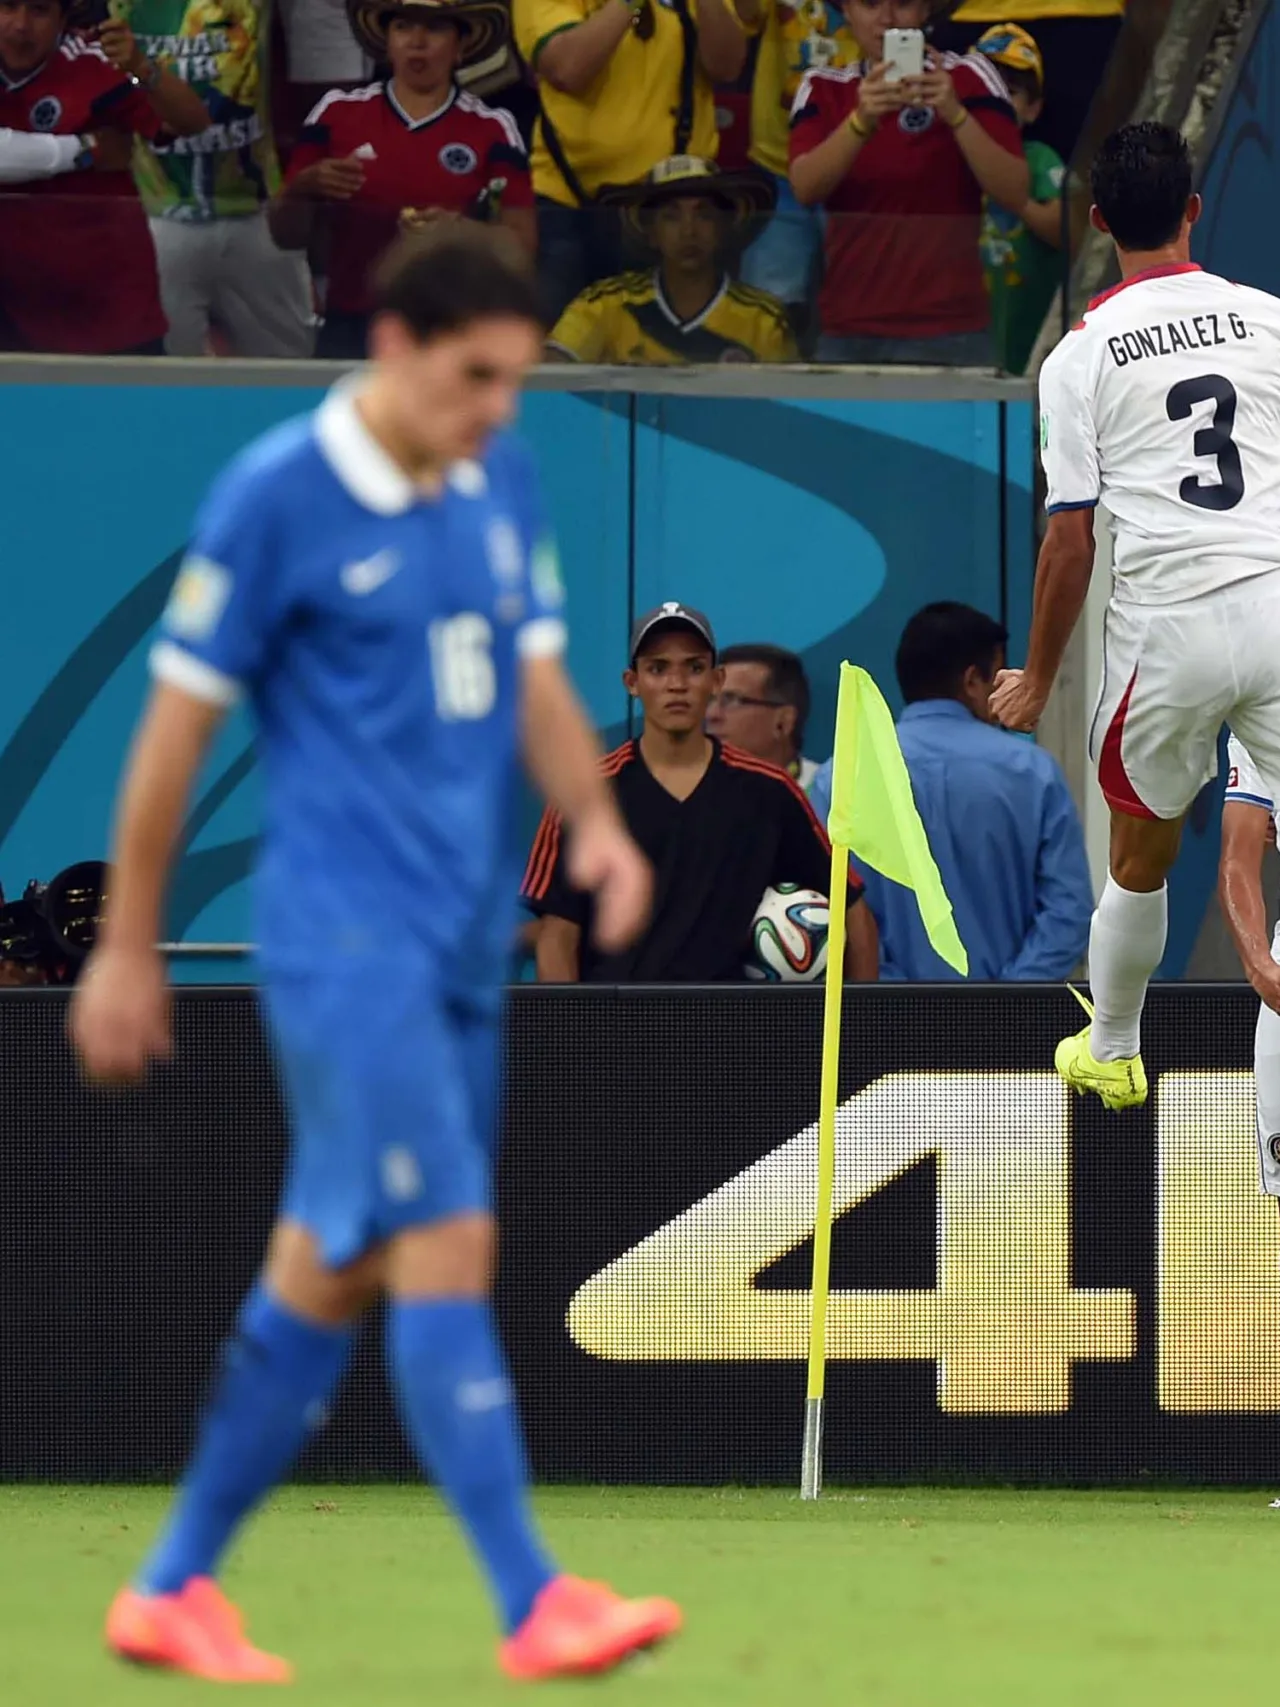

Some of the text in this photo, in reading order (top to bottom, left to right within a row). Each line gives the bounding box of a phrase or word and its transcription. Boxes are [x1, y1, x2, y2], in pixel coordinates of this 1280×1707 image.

[1108, 312, 1254, 367] GONZALEZ G.
[1166, 374, 1245, 511] 3
